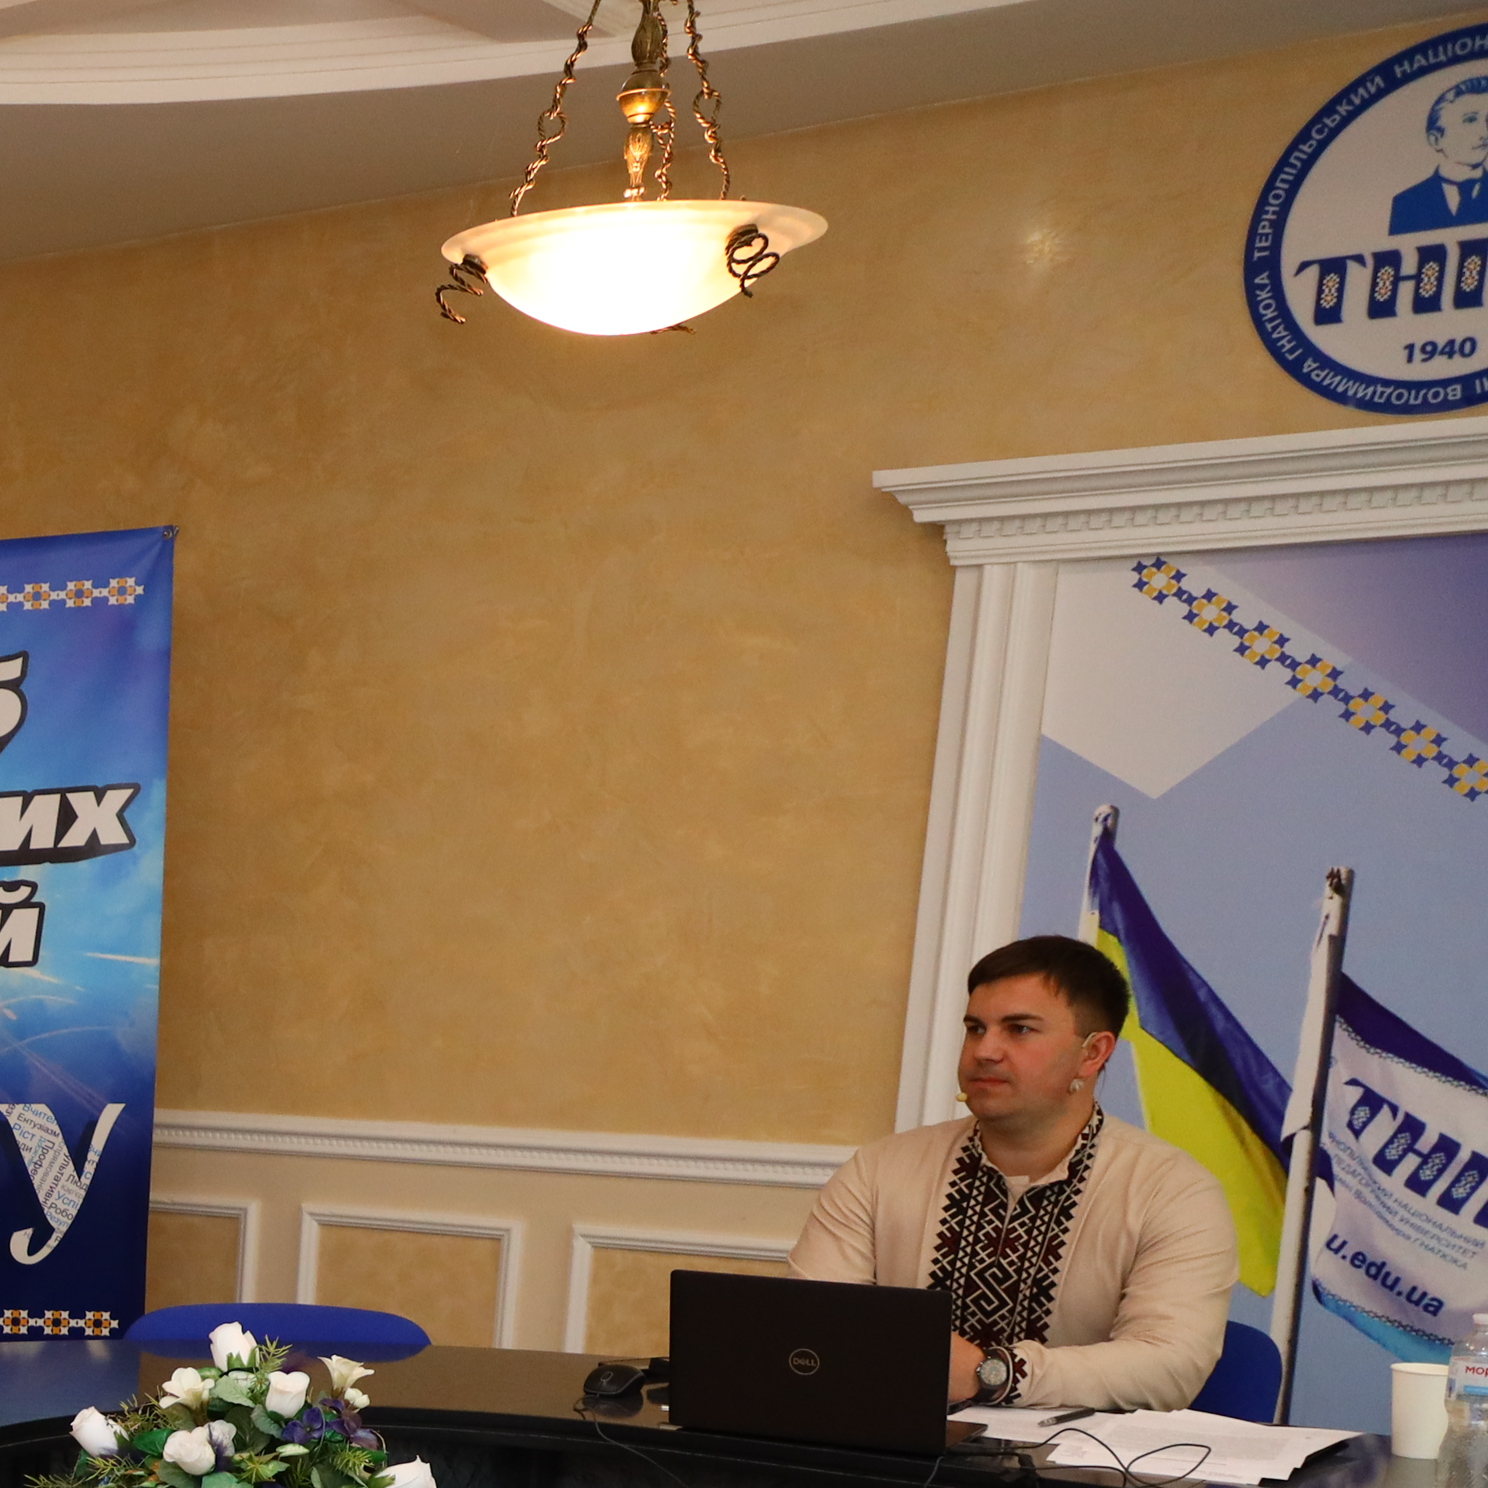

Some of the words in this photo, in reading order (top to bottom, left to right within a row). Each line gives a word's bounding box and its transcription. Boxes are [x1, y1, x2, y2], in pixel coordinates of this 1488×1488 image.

[1253, 73, 1385, 261] ТЕРНОПІЛЬСЬКИЙ
[1254, 270, 1304, 361] ГНАТЮКА
[1402, 336, 1478, 364] 1940
[1302, 357, 1462, 405] ВОЛОДИМИРА
[13, 1122, 36, 1142] Ріст
[17, 1113, 60, 1139] Ентузіазм
[1325, 1233, 1446, 1317] u.edu.ua
[793, 1357, 817, 1367] DELL
